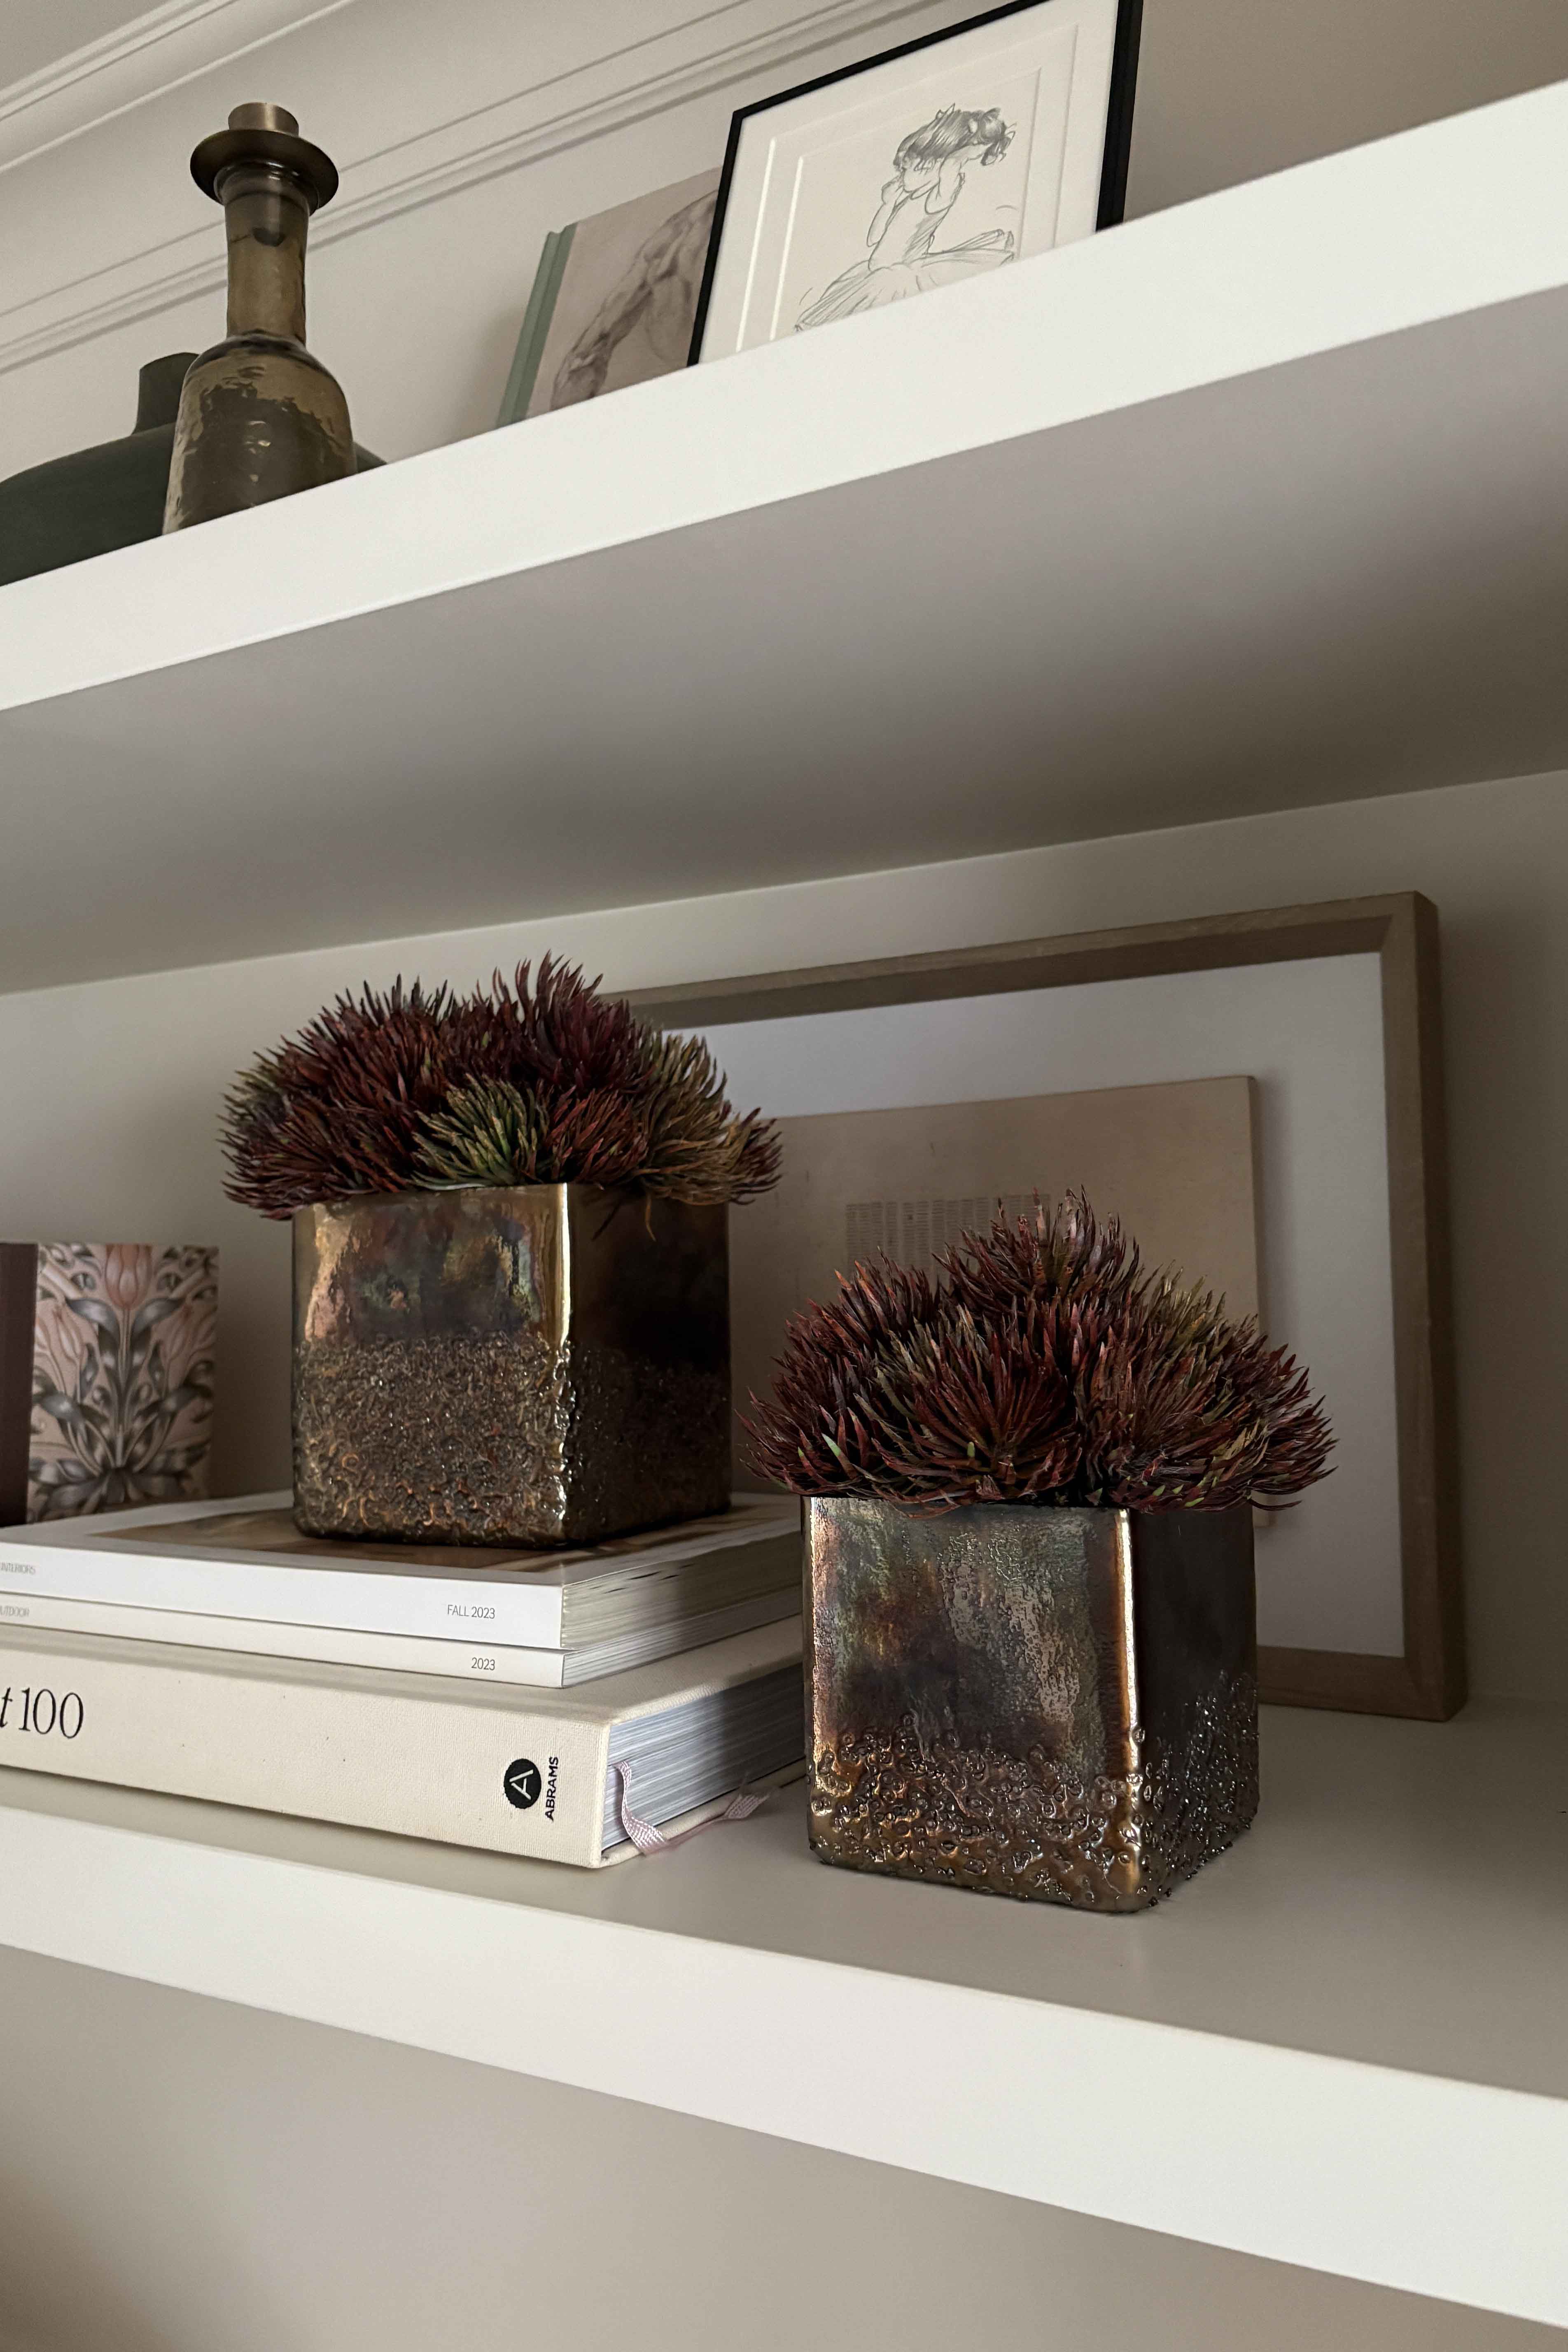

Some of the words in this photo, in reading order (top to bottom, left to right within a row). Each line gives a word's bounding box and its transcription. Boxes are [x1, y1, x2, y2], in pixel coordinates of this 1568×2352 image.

[447, 1604, 469, 1617] FALL
[471, 1606, 495, 1619] 2023
[471, 1657, 495, 1671] 2023
[18, 1687, 84, 1739] 100
[509, 1769, 534, 1800] A
[545, 1756, 558, 1822] ABRAMS
